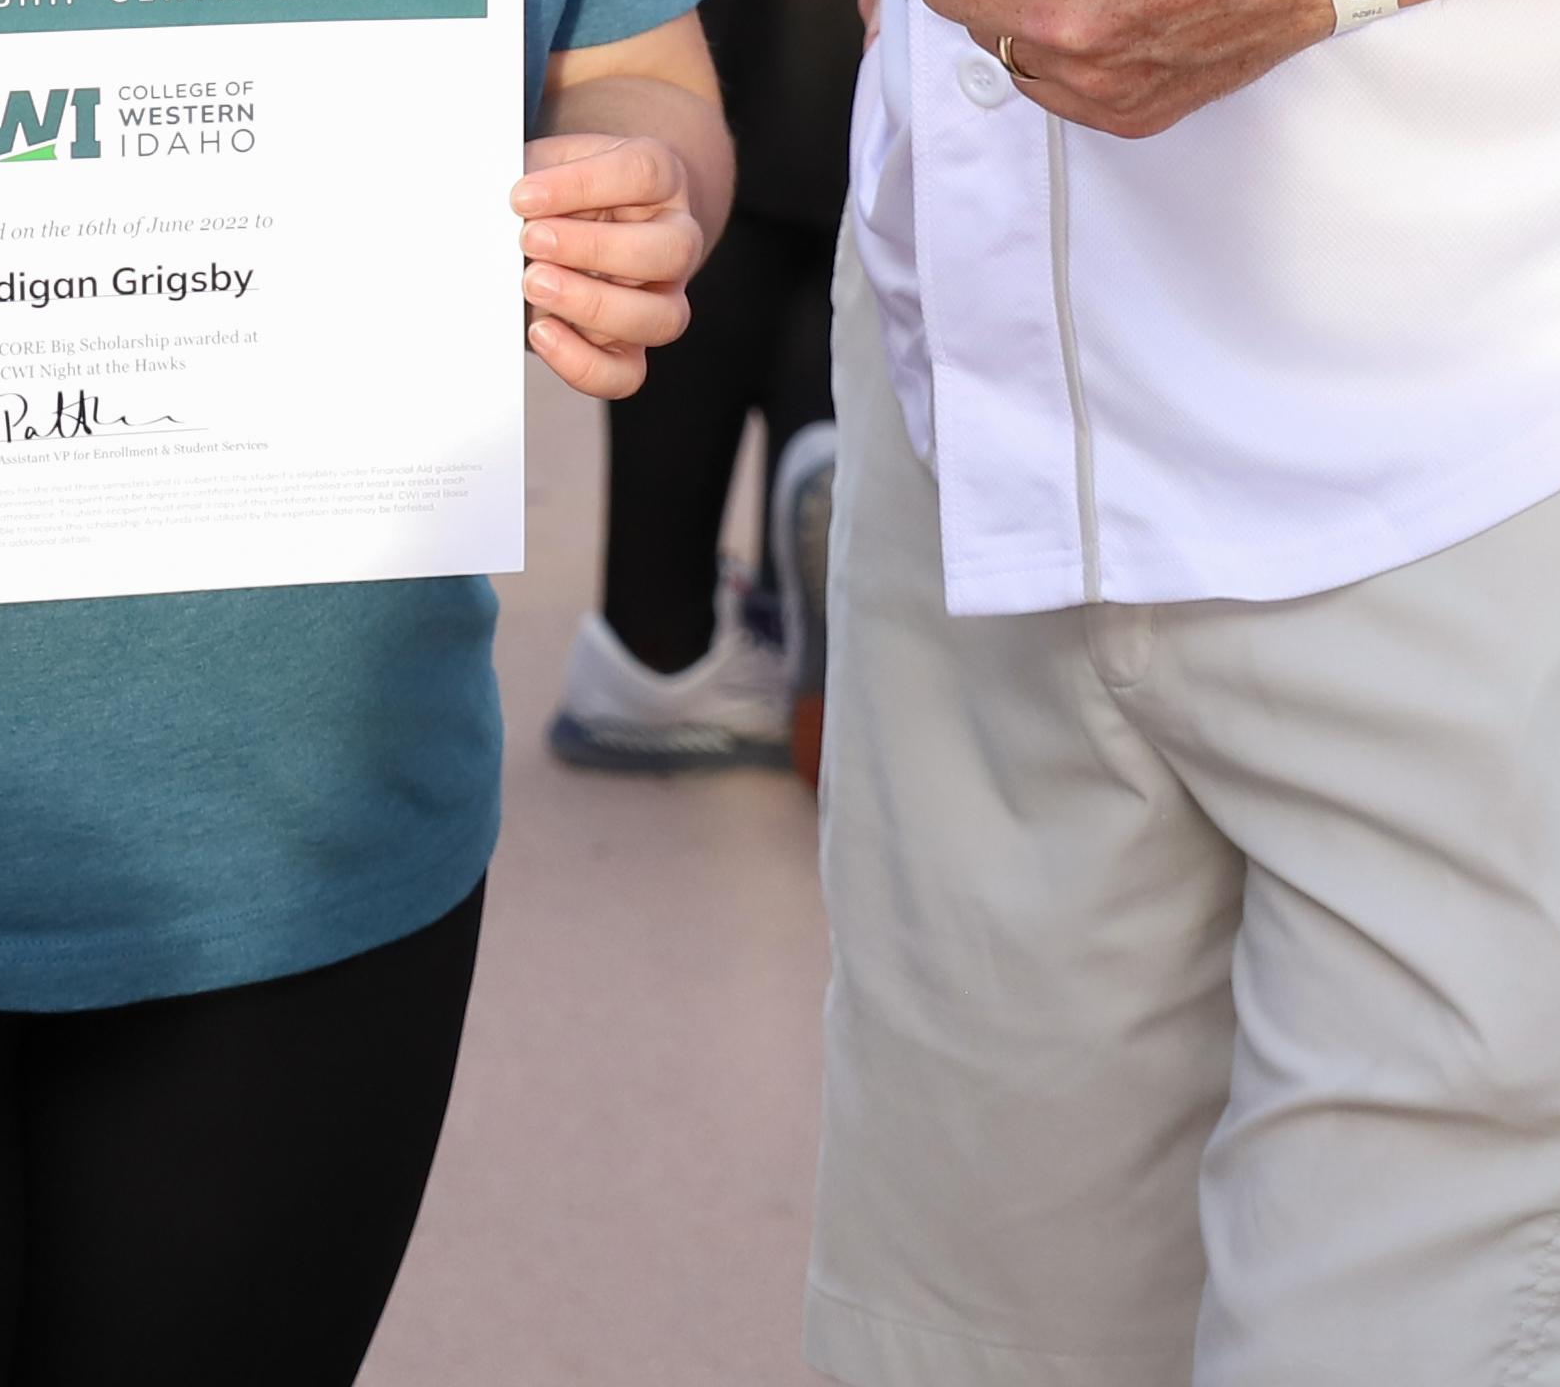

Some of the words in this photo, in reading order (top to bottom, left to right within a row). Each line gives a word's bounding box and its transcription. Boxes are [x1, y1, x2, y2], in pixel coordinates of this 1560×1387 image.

[118, 82, 216, 100] COLLEGE
[225, 81, 254, 96] OF
[118, 103, 255, 127] WESTERN
[122, 128, 256, 157] IDAHO
[11, 227, 35, 239] on
[42, 220, 70, 238] the
[77, 218, 116, 237] 16th
[123, 216, 147, 238] of
[146, 215, 194, 233] June
[200, 217, 248, 231] 2022
[255, 214, 274, 229] to
[112, 262, 254, 301] Grigsby
[51, 339, 76, 355] Big
[79, 334, 170, 353] Scholarship
[174, 330, 239, 347] awarded
[244, 331, 258, 343] at
[0, 365, 34, 380] CWI
[40, 363, 82, 381] Night
[87, 363, 101, 375] at
[106, 360, 130, 374] the
[135, 357, 186, 373] Hawks
[54, 450, 70, 462] VP
[73, 449, 90, 461] for
[94, 445, 158, 460] Enrollment
[162, 445, 170, 455] &
[174, 442, 218, 455] Student
[222, 441, 268, 453] Services
[371, 466, 413, 475] Financial
[416, 465, 432, 473] Aid
[435, 462, 482, 474] guidelines
[367, 479, 388, 487] least
[392, 478, 404, 486] six
[408, 476, 439, 485] credits
[442, 475, 464, 483] each
[398, 491, 419, 499] CWI
[422, 490, 439, 498] and
[393, 502, 435, 511] forfeited.
